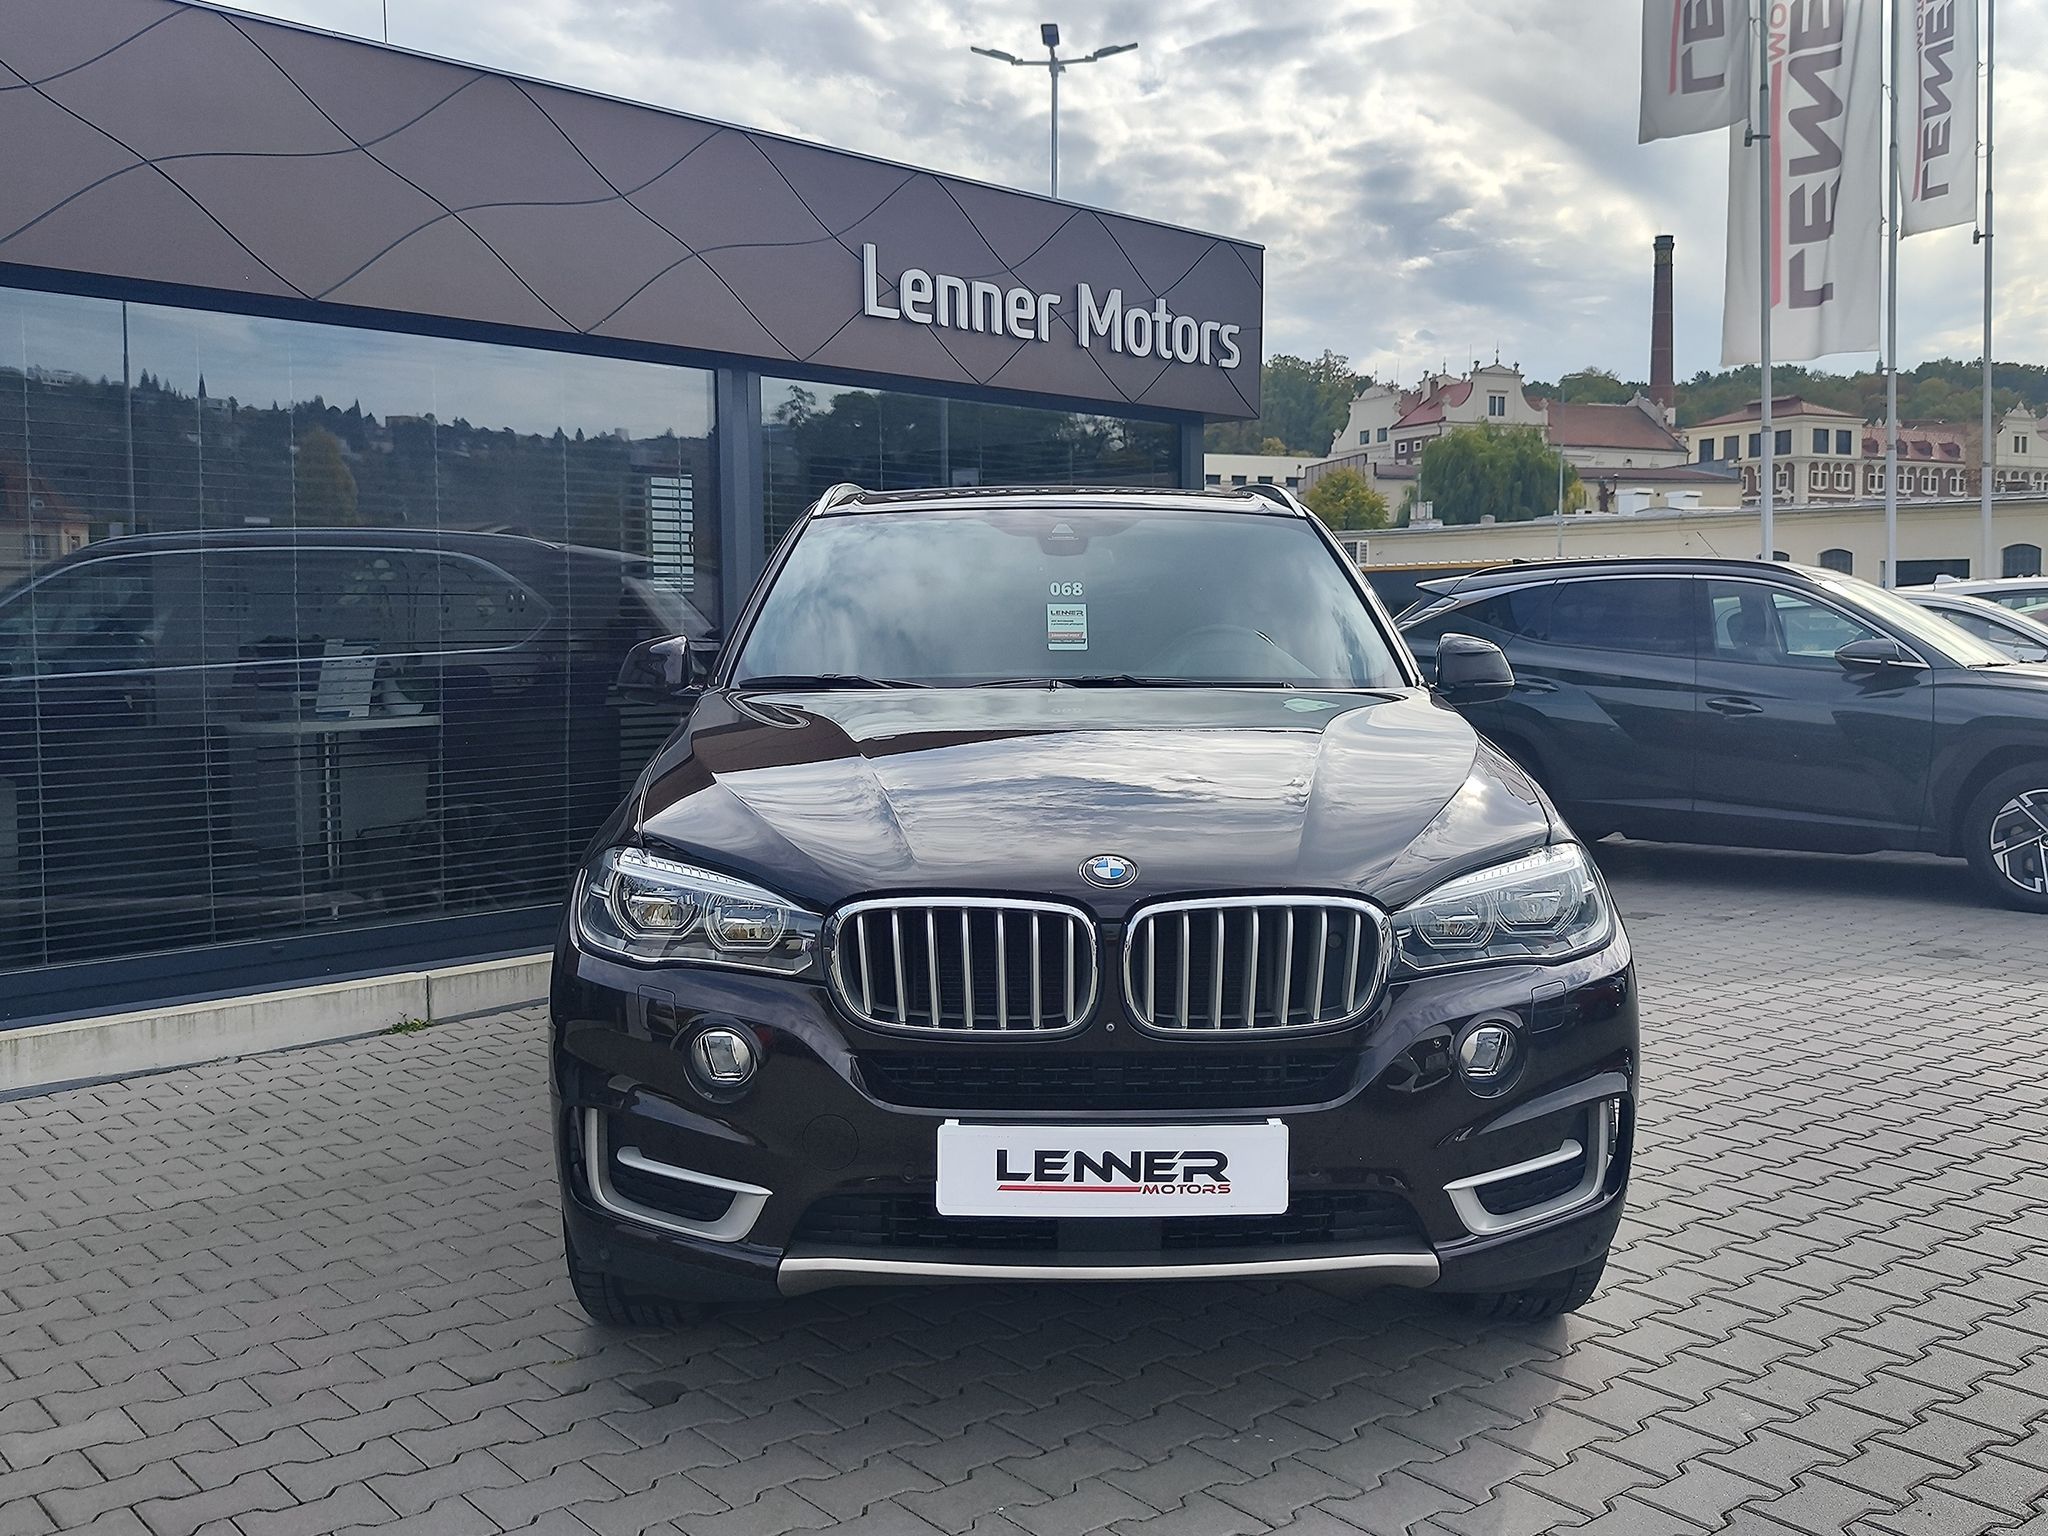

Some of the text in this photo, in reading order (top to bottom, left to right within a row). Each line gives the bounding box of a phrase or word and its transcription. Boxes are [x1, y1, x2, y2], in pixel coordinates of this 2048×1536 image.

[862, 243, 1241, 369] Lenner Motors
[1049, 582, 1084, 596] 068
[996, 1149, 1231, 1183] LENNER
[1142, 1184, 1231, 1195] MOTORS
